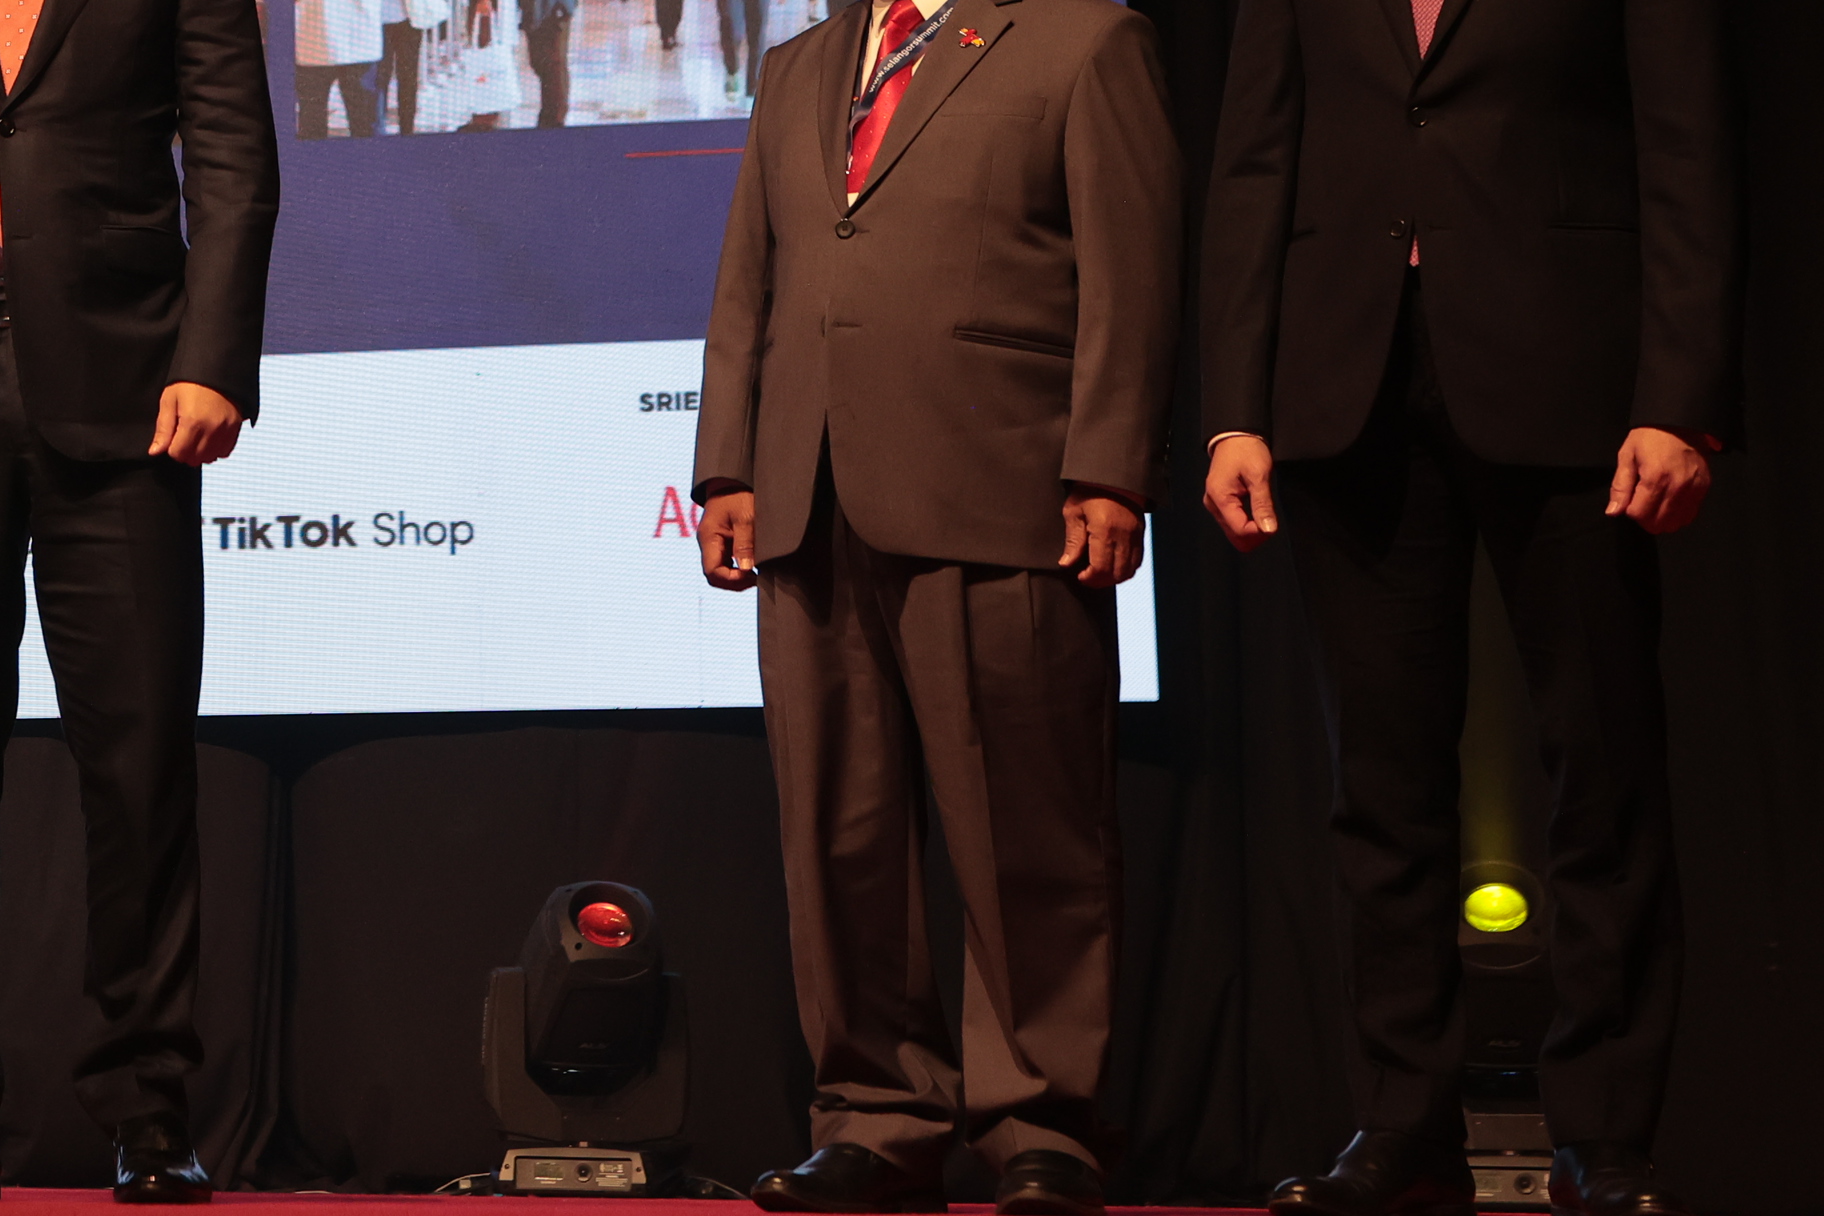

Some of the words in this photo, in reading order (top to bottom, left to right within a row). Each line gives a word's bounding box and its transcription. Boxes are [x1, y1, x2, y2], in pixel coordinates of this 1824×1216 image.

[869, 7, 954, 93] www.selangorsummit.com
[213, 514, 357, 550] TikTok
[373, 510, 475, 555] Shop
